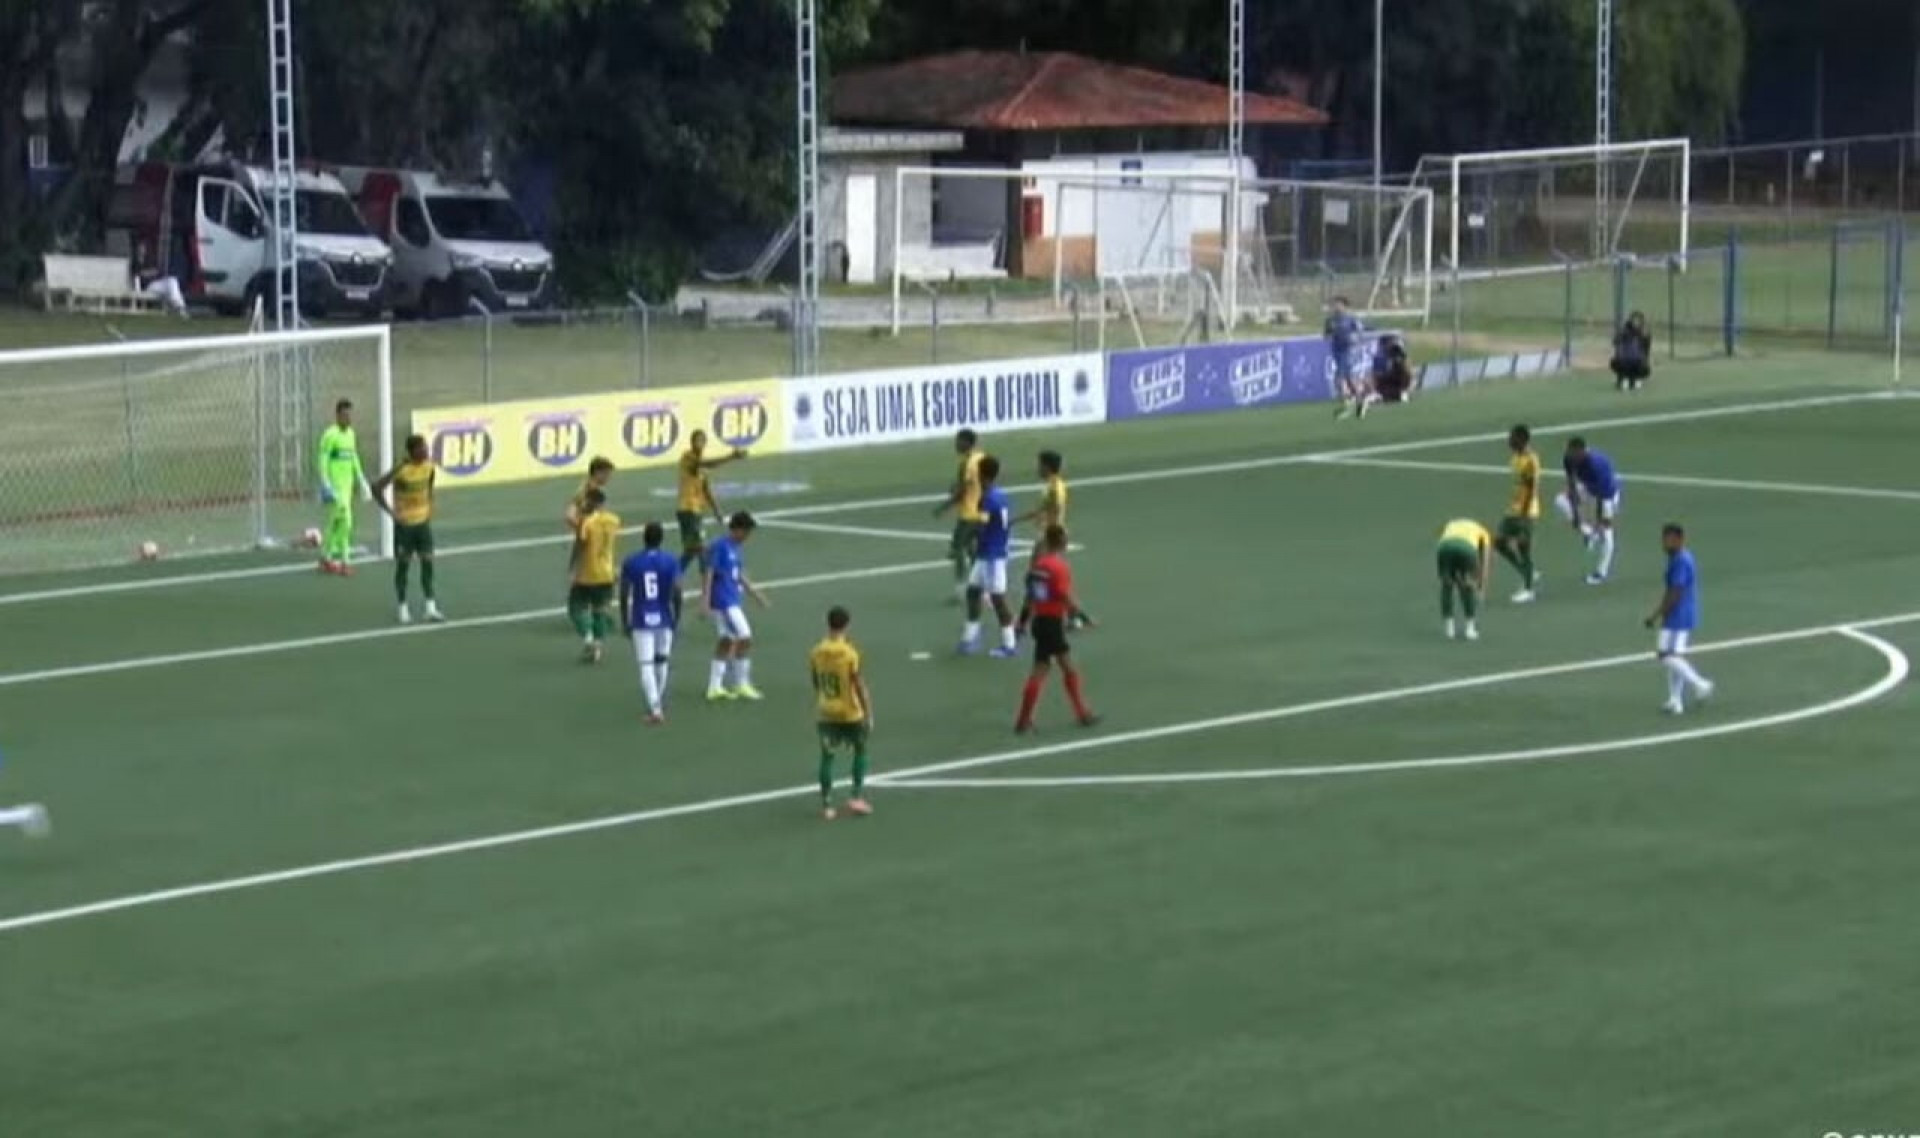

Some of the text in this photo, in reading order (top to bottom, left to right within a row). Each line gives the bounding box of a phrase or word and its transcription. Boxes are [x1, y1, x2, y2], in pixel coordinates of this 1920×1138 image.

[823, 370, 1061, 437] SEJA UMA ESCOLA OFICIAL
[632, 413, 671, 448] BH
[722, 404, 760, 439] BH
[442, 431, 484, 467] BH
[539, 423, 578, 458] BH
[644, 571, 658, 599] 6
